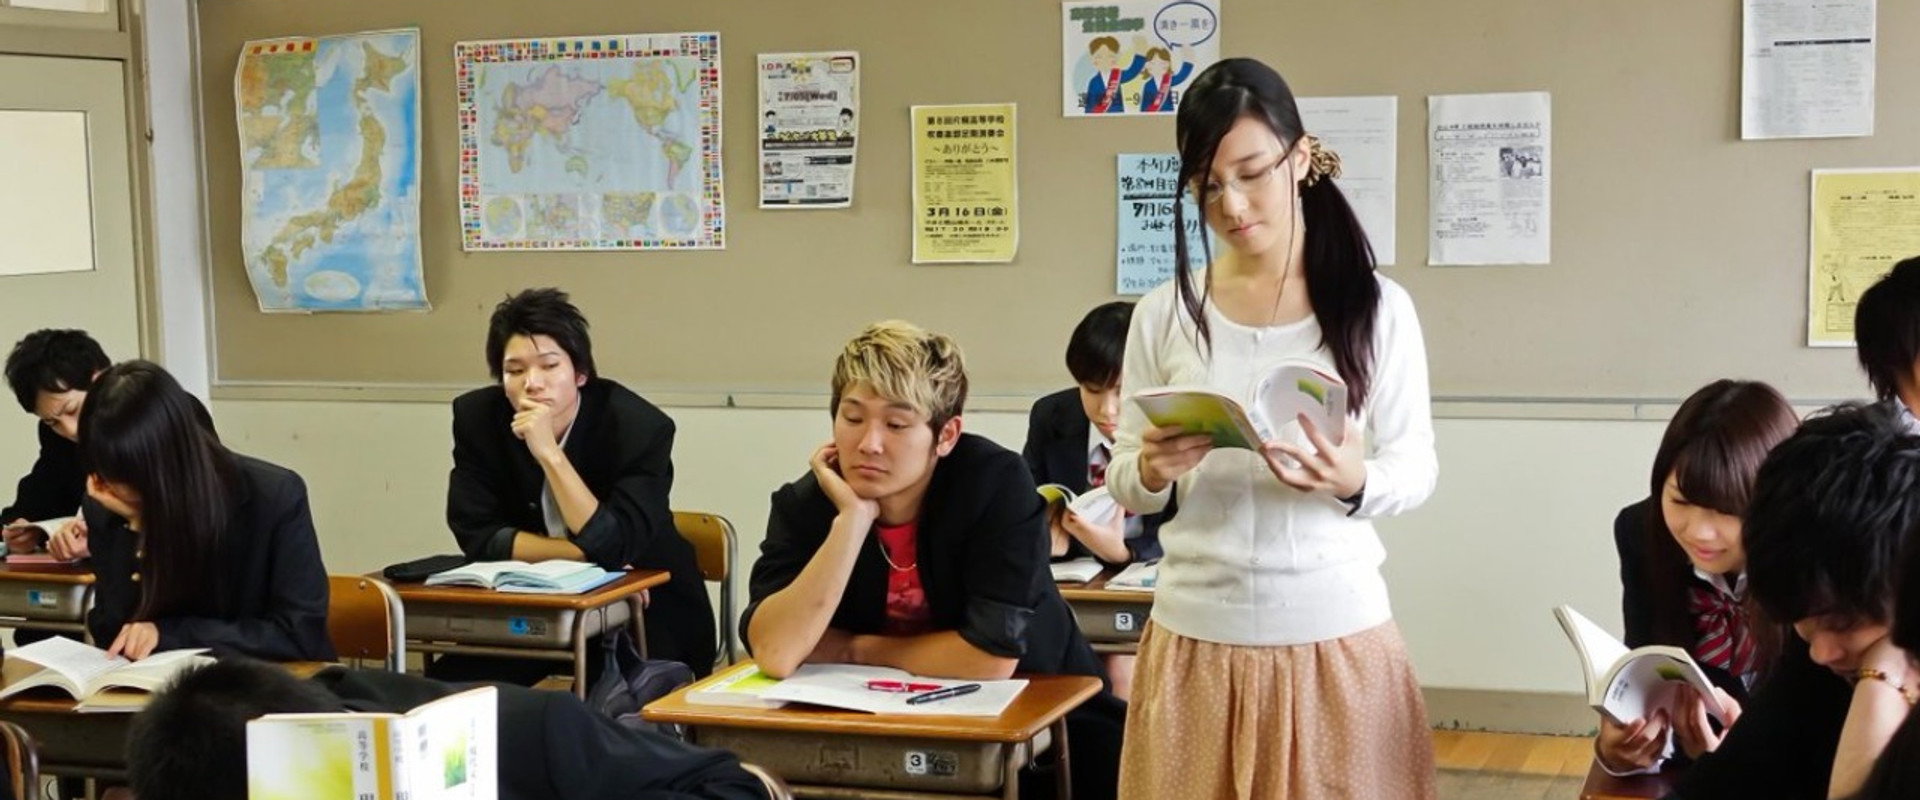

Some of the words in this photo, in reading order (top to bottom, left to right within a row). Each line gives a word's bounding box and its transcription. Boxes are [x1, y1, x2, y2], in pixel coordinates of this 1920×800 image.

[1132, 202, 1177, 218] 7月16
[1119, 614, 1129, 624] 3
[910, 754, 922, 767] 3
